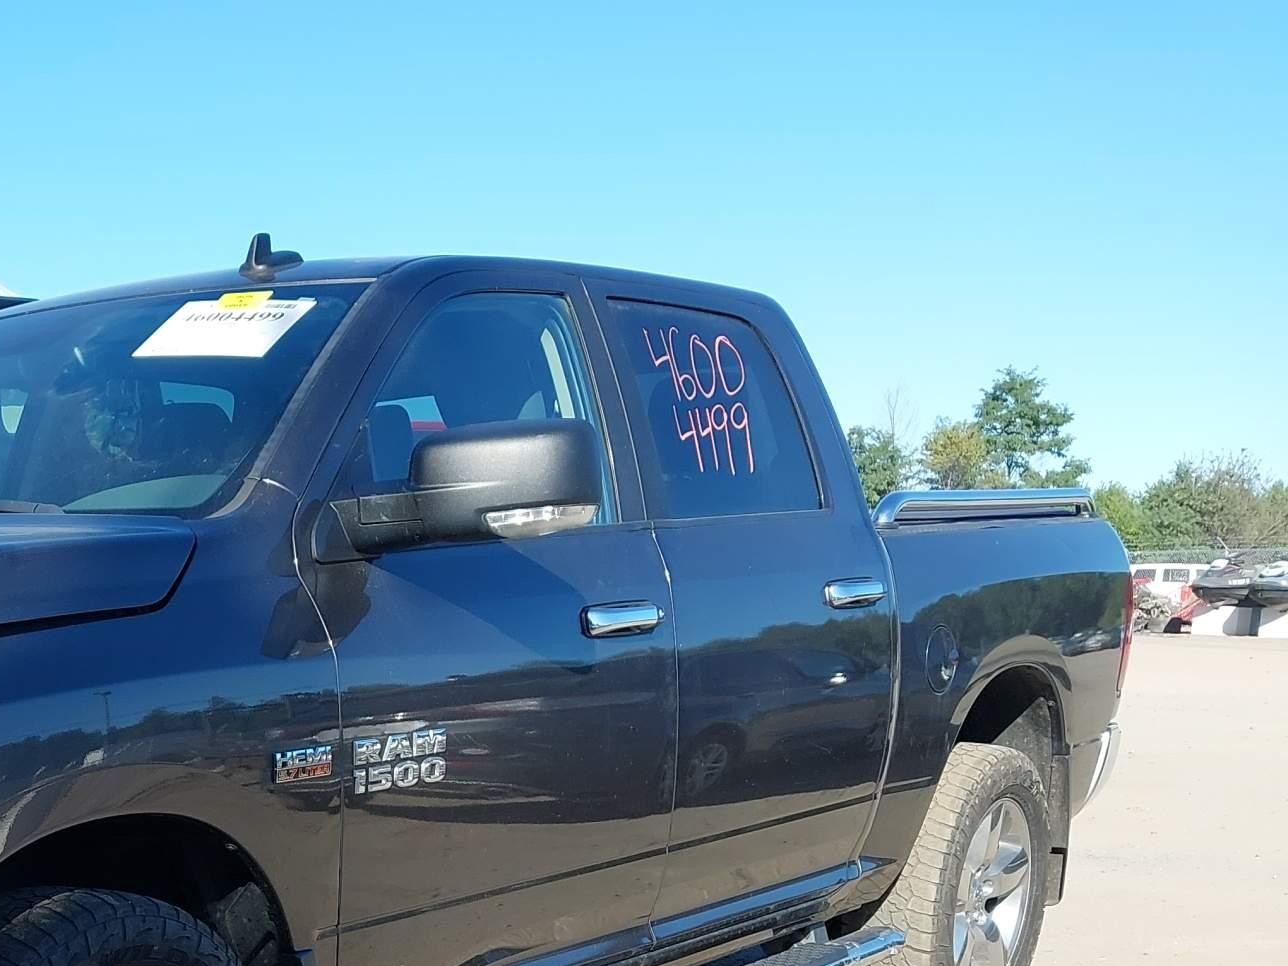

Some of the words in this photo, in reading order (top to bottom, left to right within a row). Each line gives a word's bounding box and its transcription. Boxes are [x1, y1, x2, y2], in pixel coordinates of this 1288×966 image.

[642, 326, 745, 402] 4600
[672, 402, 755, 476] 4499
[275, 746, 332, 769] HEMI
[353, 728, 448, 766] RAM
[353, 757, 448, 795] 1500
